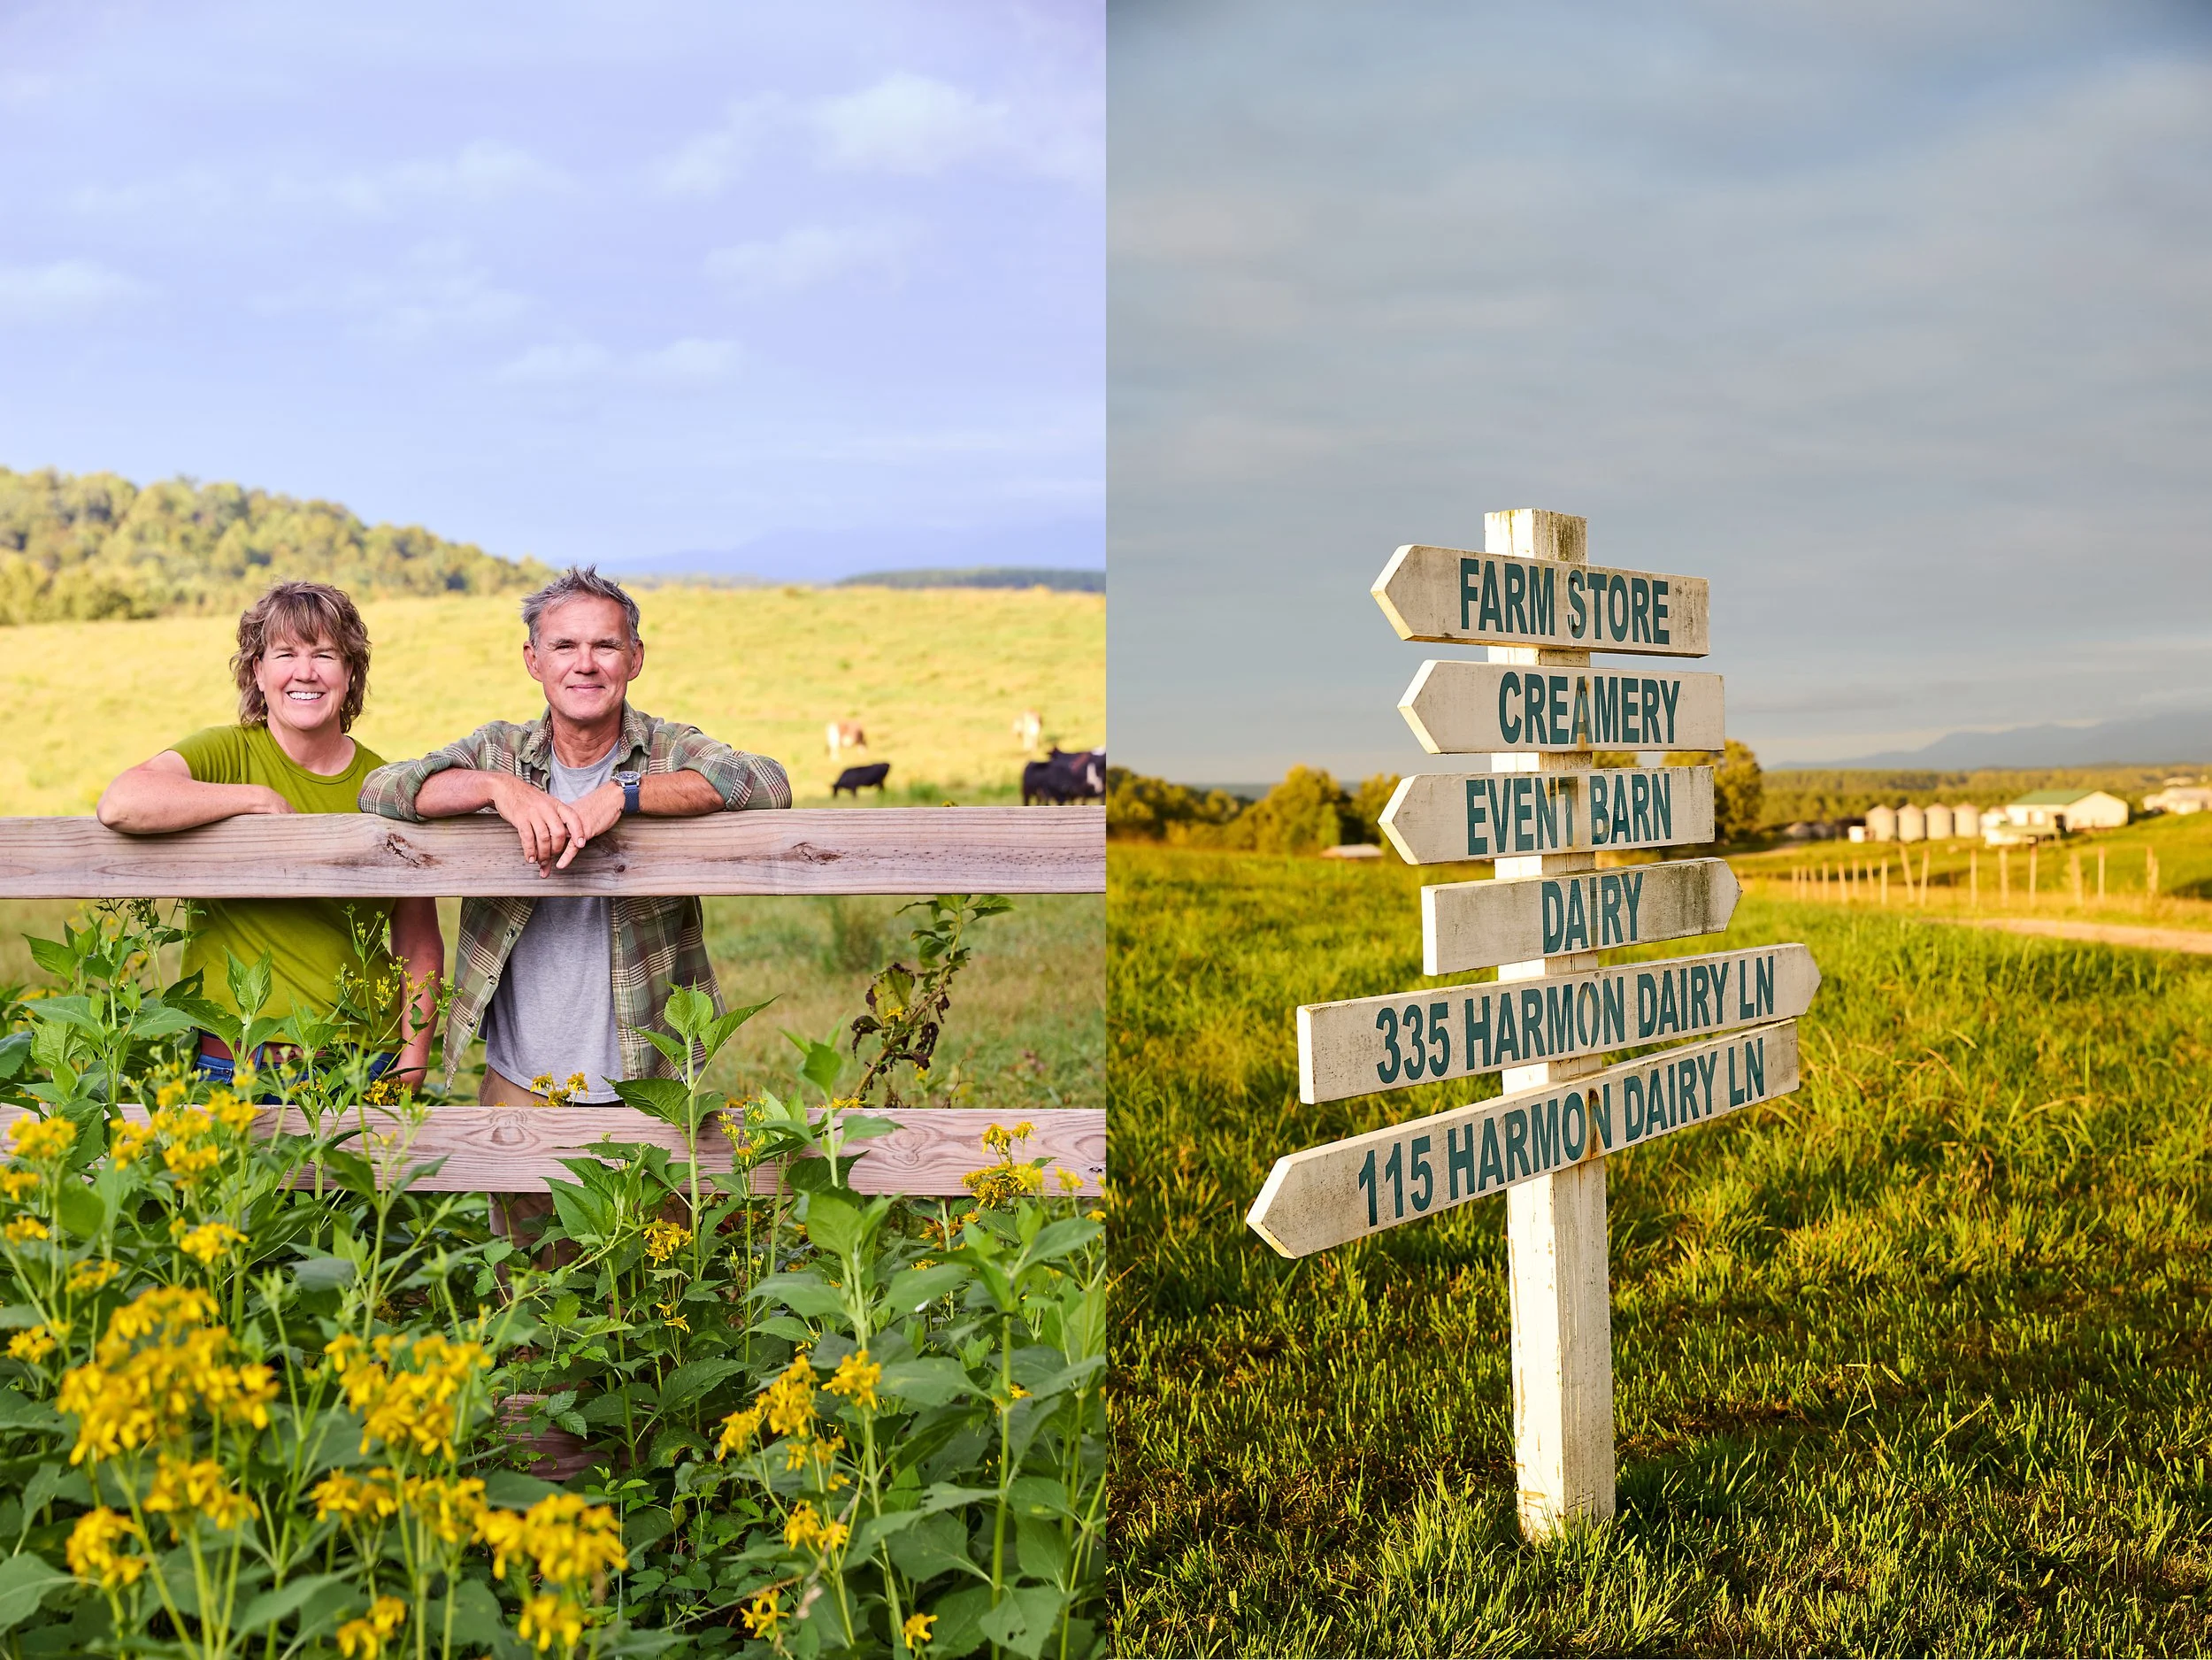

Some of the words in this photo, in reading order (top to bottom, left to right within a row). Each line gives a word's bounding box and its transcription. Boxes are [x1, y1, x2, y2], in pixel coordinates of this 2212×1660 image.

[1460, 557, 1555, 636] FARM
[1567, 569, 1670, 645] STORE
[1499, 672, 1680, 745] CREAMERY
[1466, 776, 1578, 856] EVENT
[1589, 772, 1672, 845] BARN
[1542, 872, 1643, 955] DAIRY
[1375, 1002, 1451, 1084] 335
[1465, 976, 1626, 1071] HARMON
[1637, 961, 1729, 1039] DAIRY
[1739, 956, 1775, 1018] LN
[1358, 1135, 1433, 1226] 115
[1448, 1083, 1611, 1201] HARMON
[1624, 1050, 1719, 1142] DAIRY
[1728, 1037, 1765, 1108] LN
